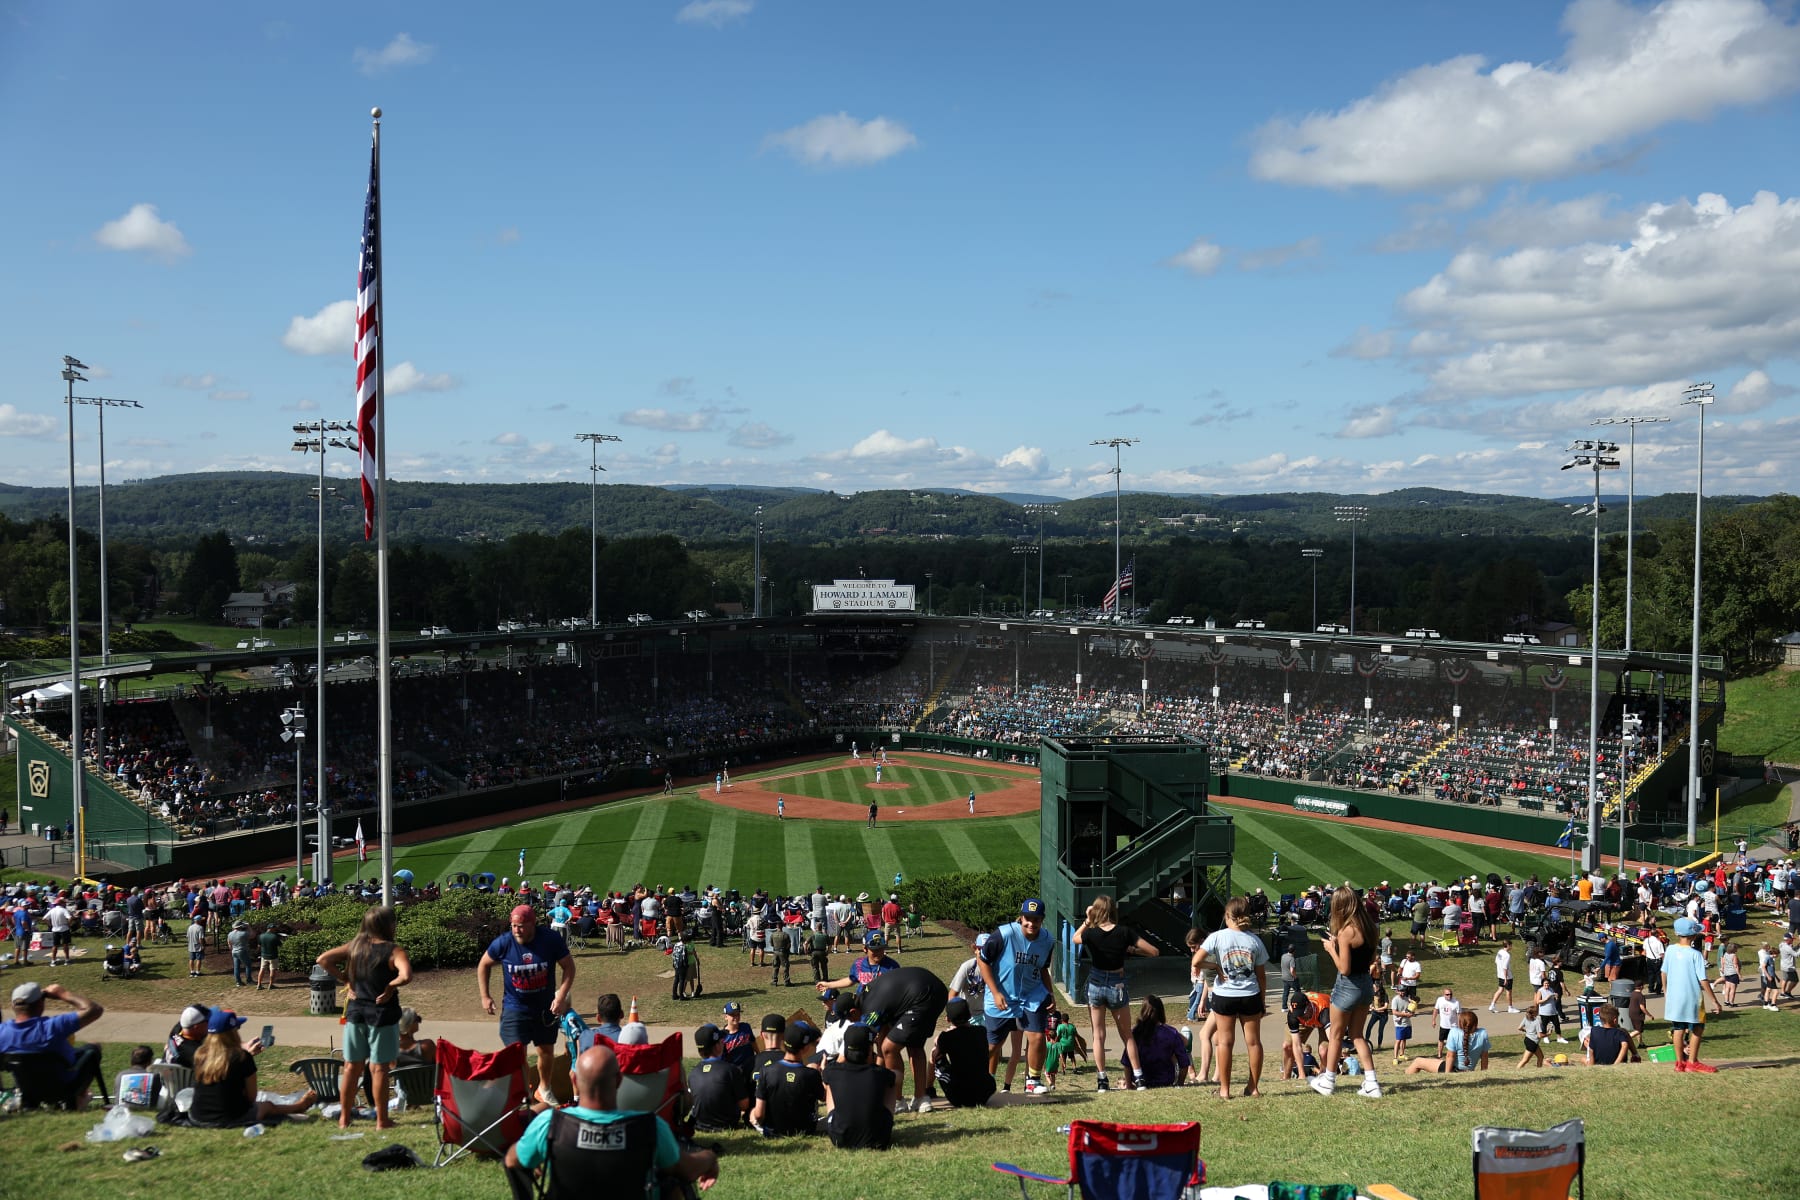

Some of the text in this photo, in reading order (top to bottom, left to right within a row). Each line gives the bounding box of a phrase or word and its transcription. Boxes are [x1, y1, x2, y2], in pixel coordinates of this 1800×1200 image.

[820, 591, 859, 599] HOWARD
[870, 591, 908, 599] LAMADE
[1016, 951, 1040, 966] HEAT
[581, 1129, 624, 1145] DICK'S
